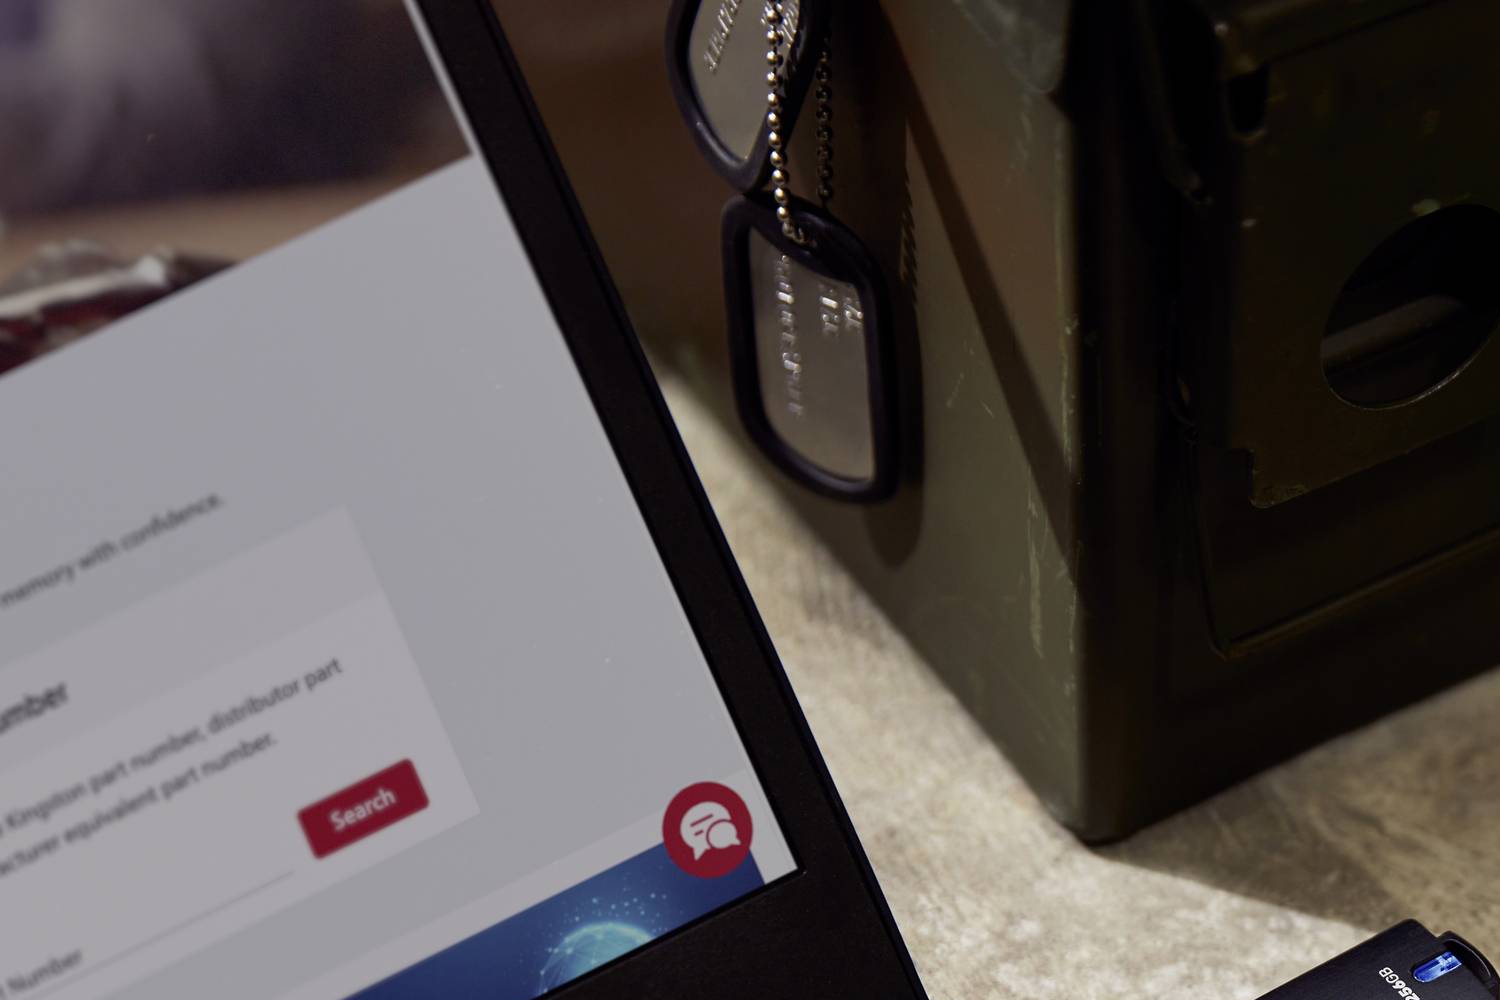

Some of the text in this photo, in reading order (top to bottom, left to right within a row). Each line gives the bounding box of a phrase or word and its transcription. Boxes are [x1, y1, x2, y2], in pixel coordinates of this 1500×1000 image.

[89, 760, 129, 794] part
[207, 679, 301, 735] distributor
[303, 657, 343, 691] part
[160, 766, 200, 800] part
[329, 787, 397, 832] Search
